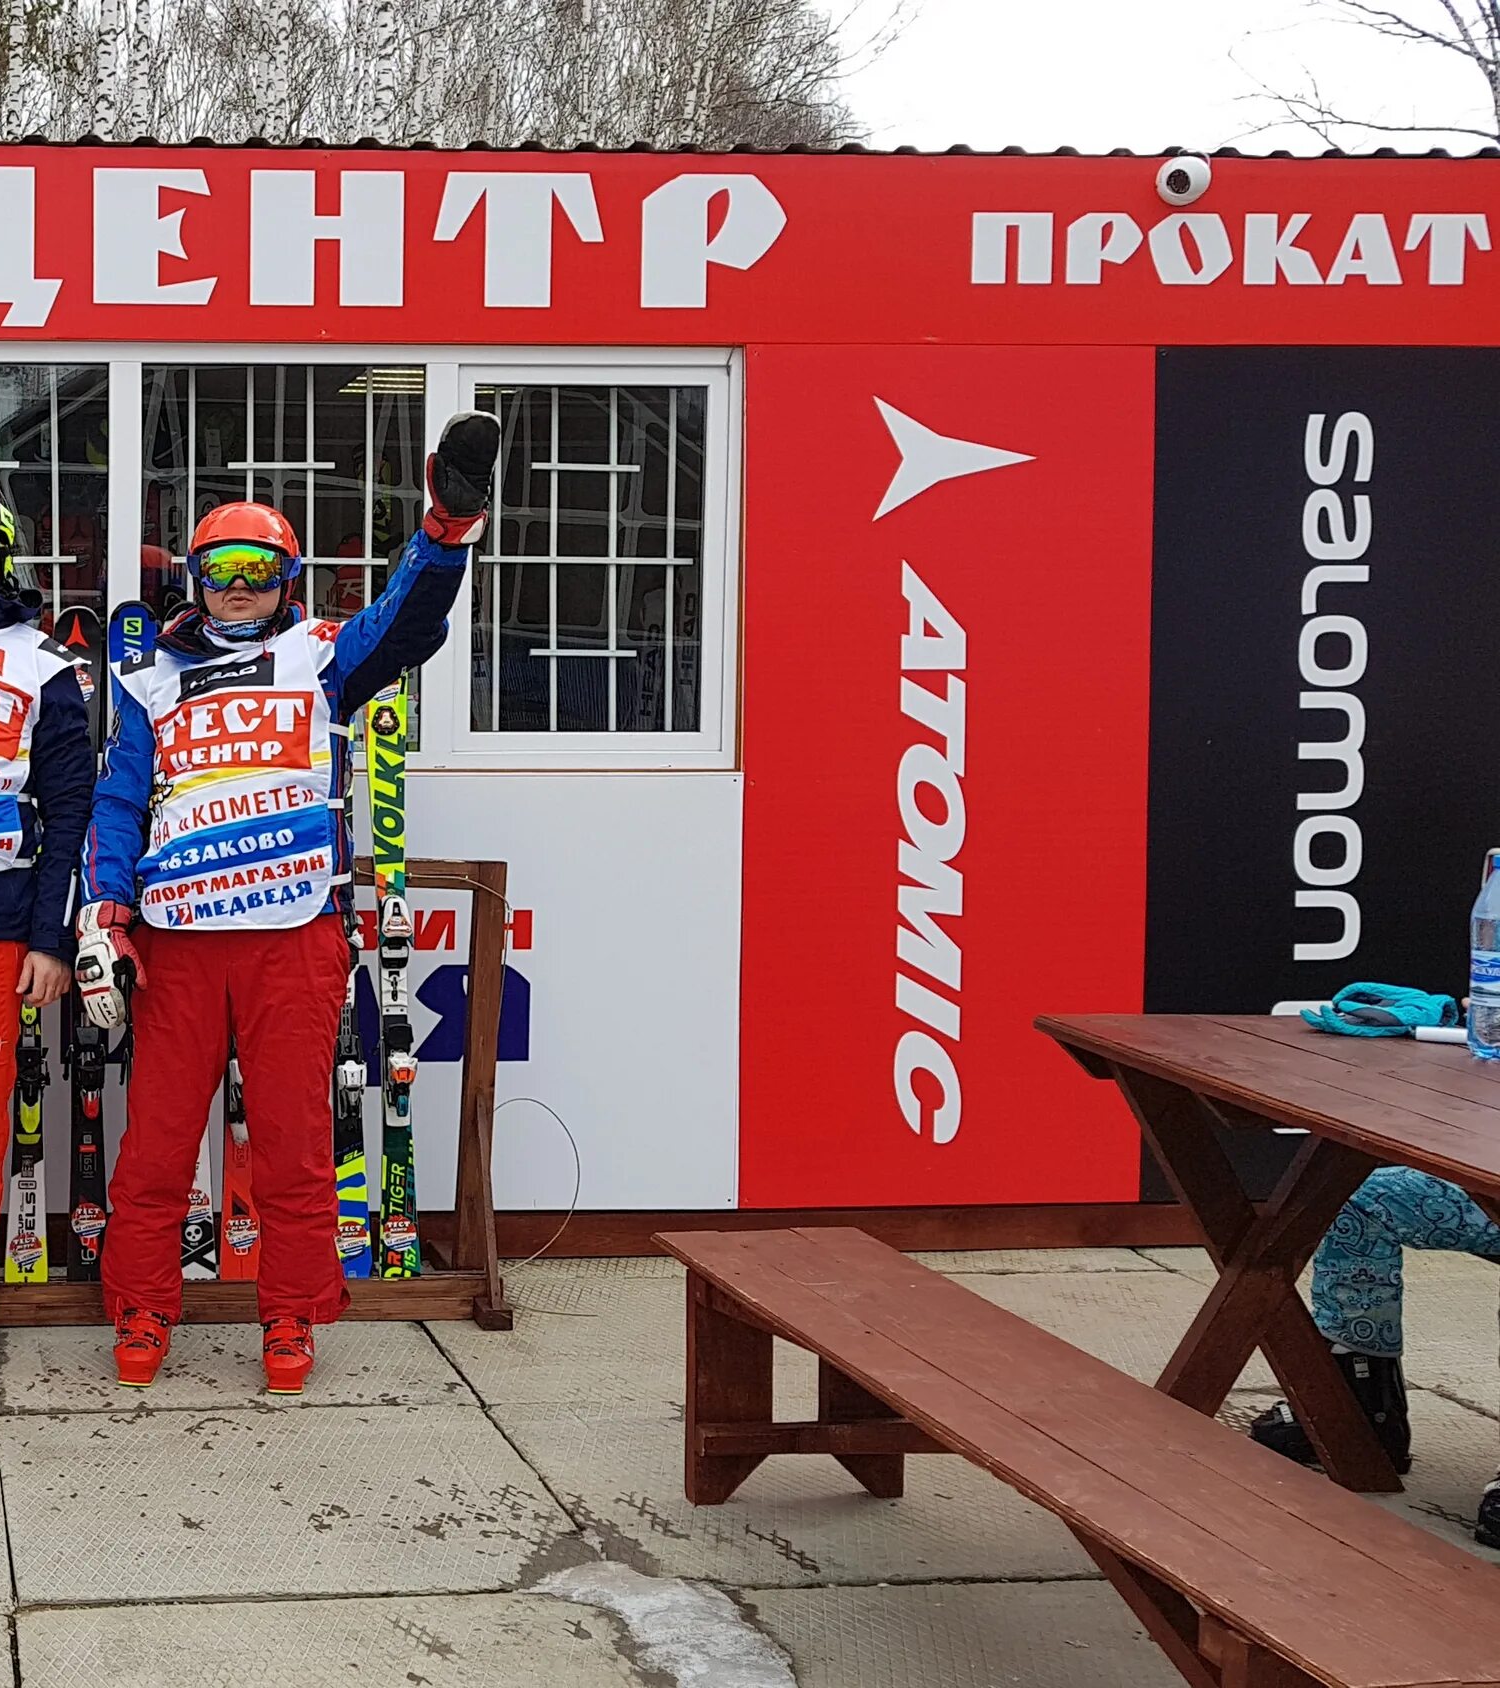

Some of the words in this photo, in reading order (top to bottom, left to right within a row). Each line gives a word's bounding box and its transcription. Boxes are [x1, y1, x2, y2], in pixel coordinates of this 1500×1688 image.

[970, 211, 1493, 286] ПРОКАТ
[190, 665, 258, 689] HEAD
[157, 698, 306, 748] ТЕСТ
[170, 741, 283, 772] ЦЕНТР
[893, 559, 967, 1145] ATOMIC
[145, 854, 325, 906] СПОРТМАГАЗИН
[194, 880, 313, 921] МЕДВЕДЯ
